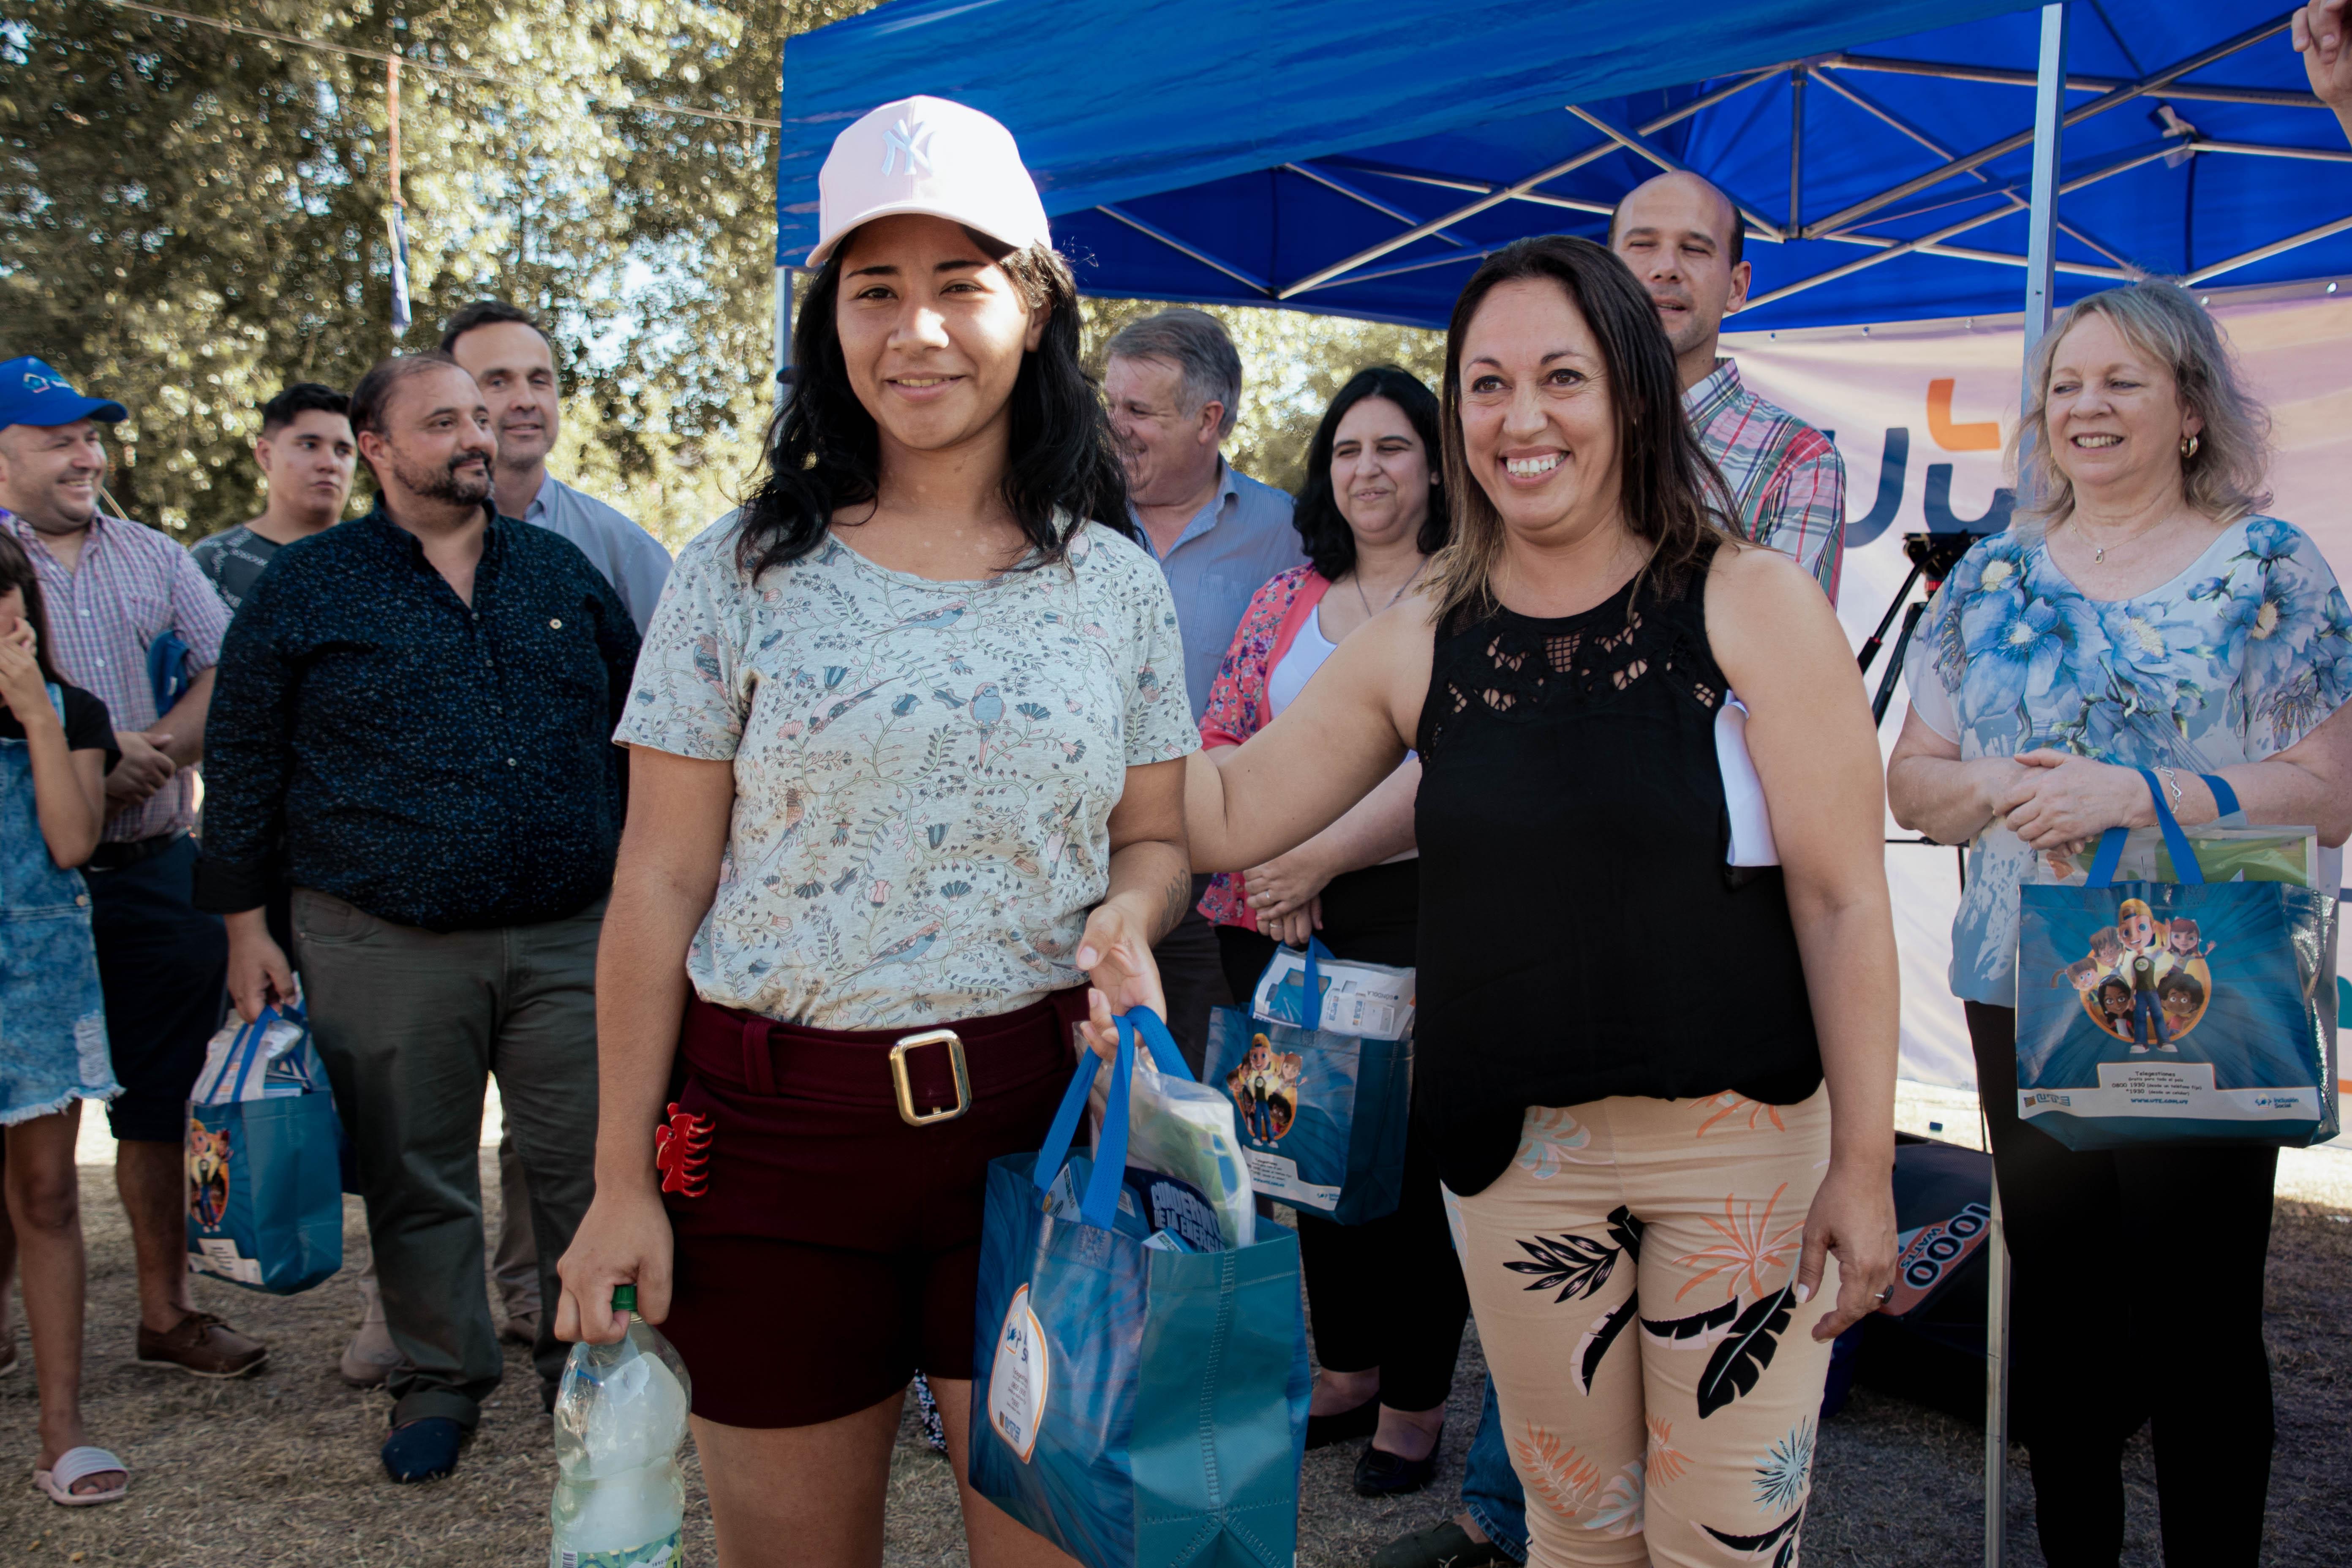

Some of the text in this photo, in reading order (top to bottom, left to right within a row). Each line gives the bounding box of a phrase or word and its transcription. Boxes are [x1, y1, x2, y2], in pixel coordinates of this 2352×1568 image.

[881, 118, 937, 177] NY
[1154, 1209, 1166, 1228] DE
[1900, 1227, 1941, 1268] WATTS
[1903, 1202, 1991, 1290] 1000
